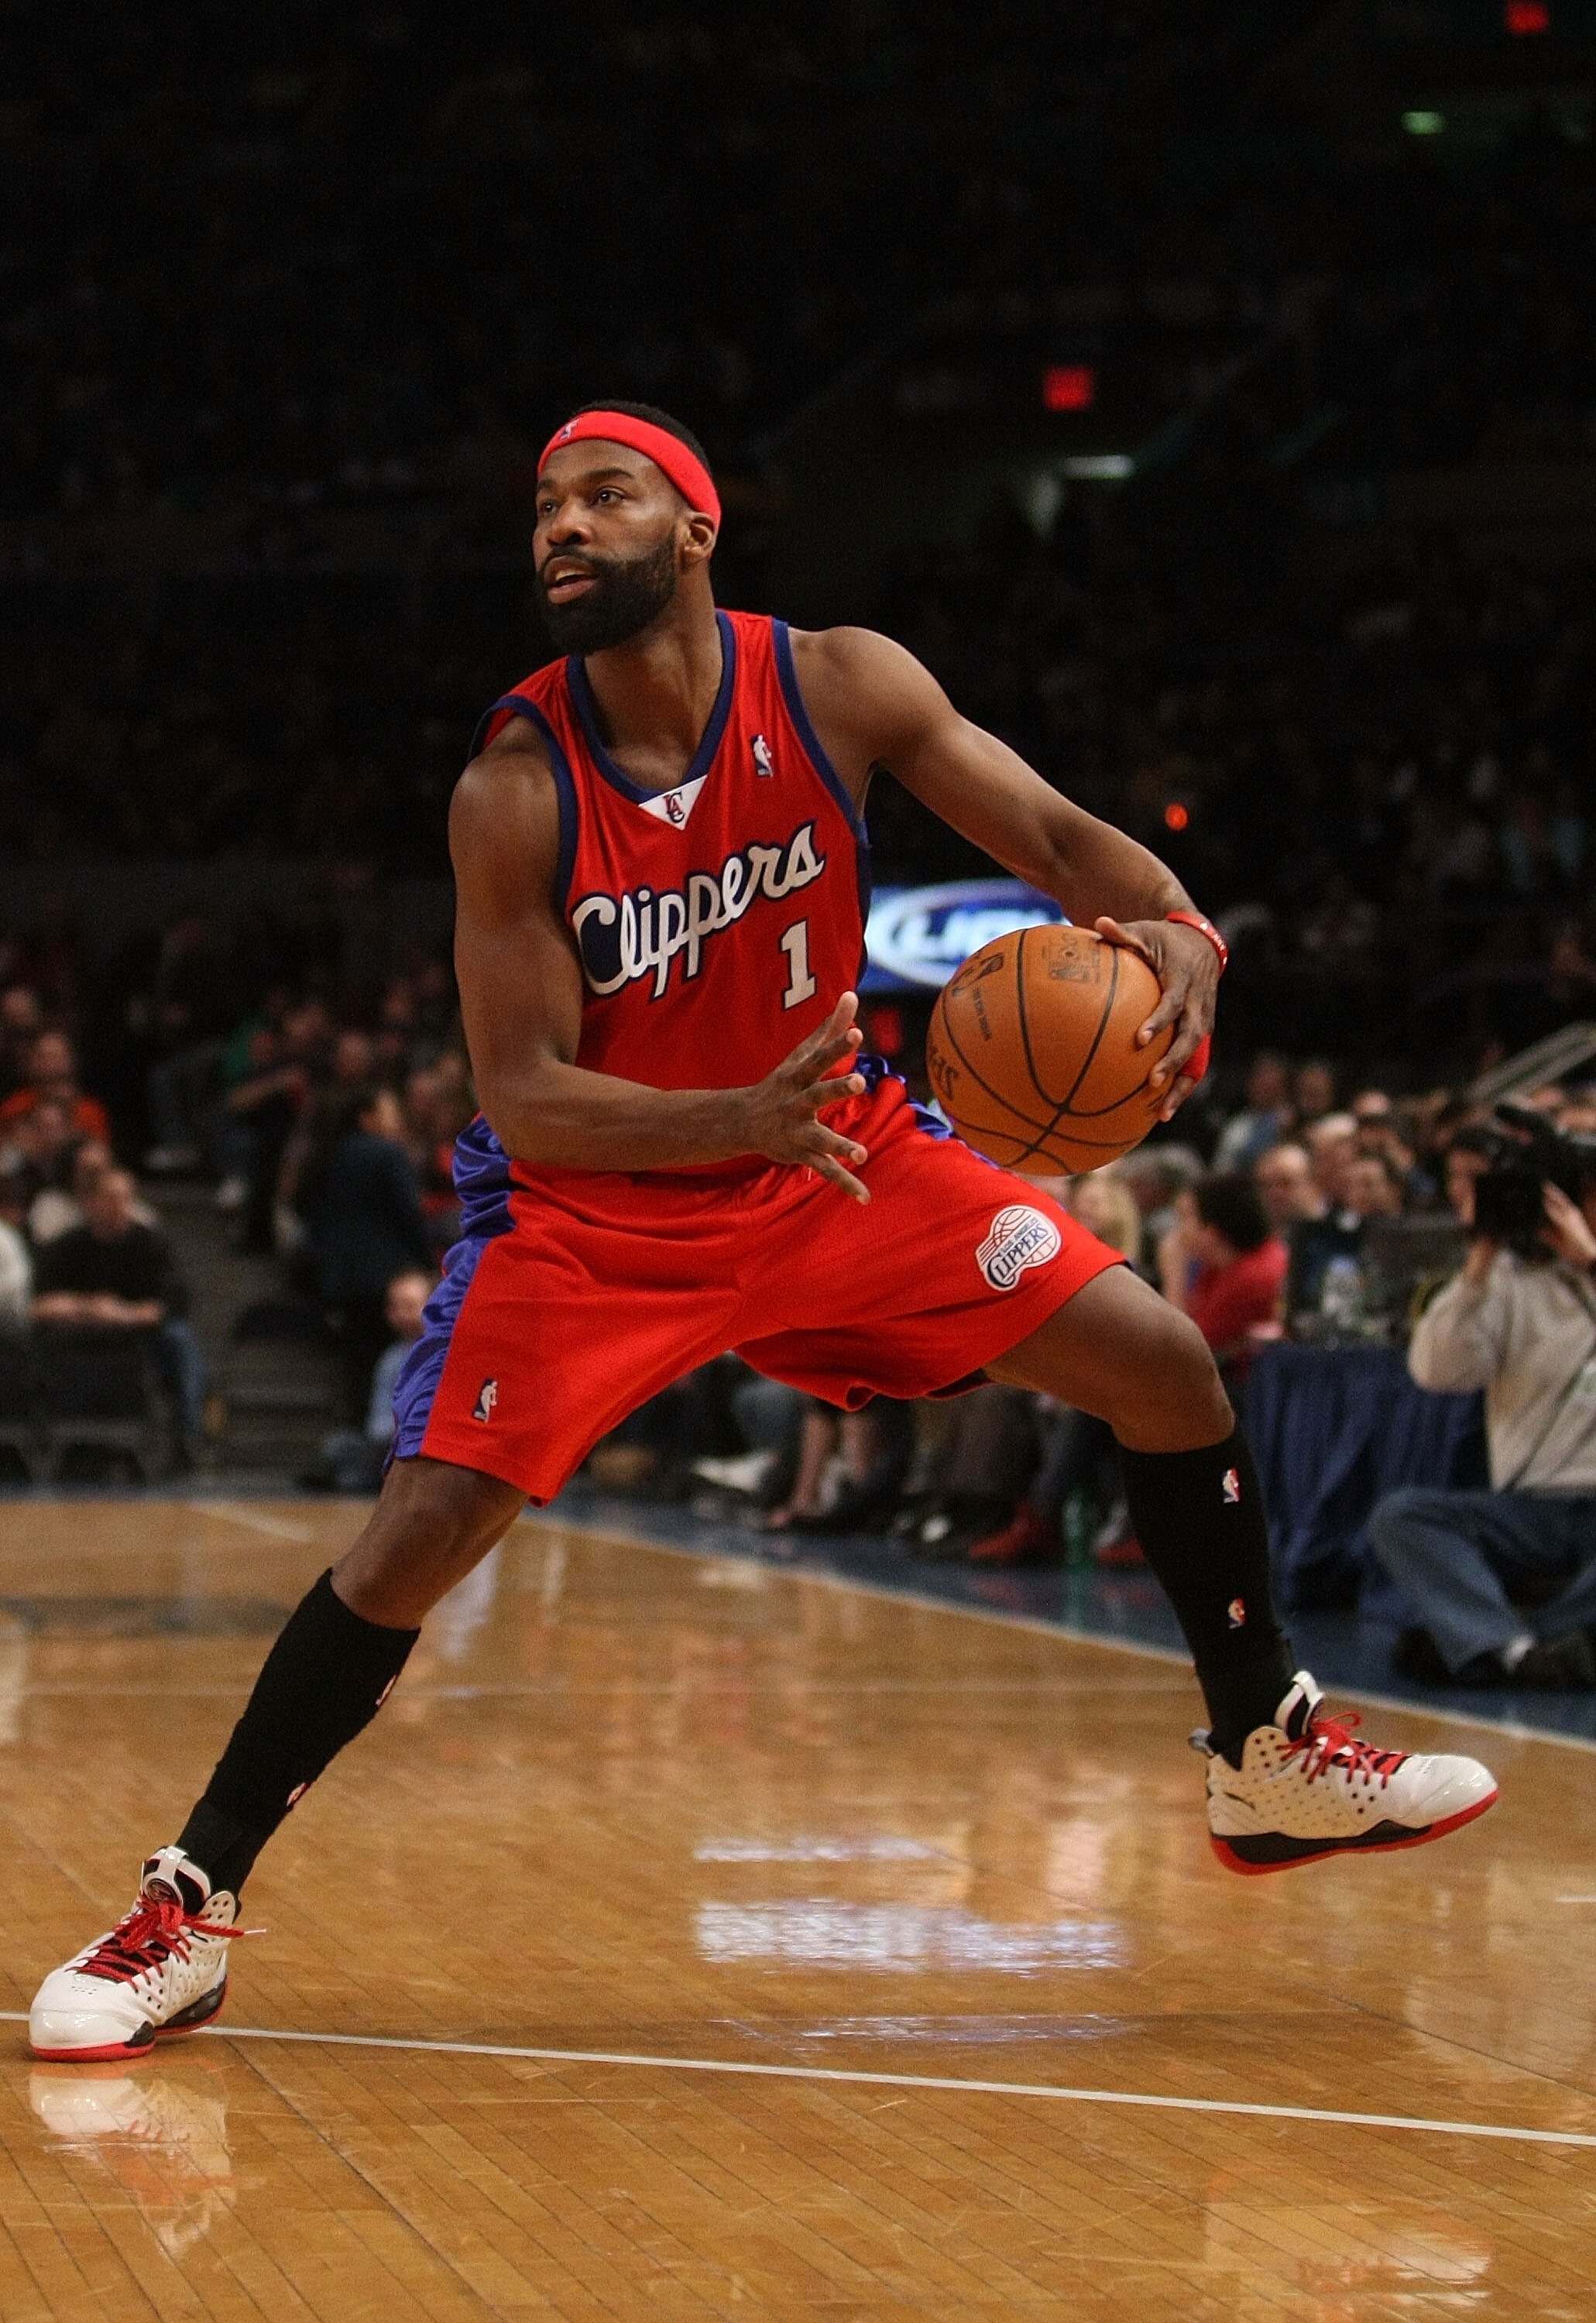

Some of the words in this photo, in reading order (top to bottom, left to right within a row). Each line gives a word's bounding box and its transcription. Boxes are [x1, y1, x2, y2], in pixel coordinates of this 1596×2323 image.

[571, 822, 825, 1000] Clippers
[781, 920, 815, 1010] 1
[987, 1223, 1049, 1288] CLIPPERS
